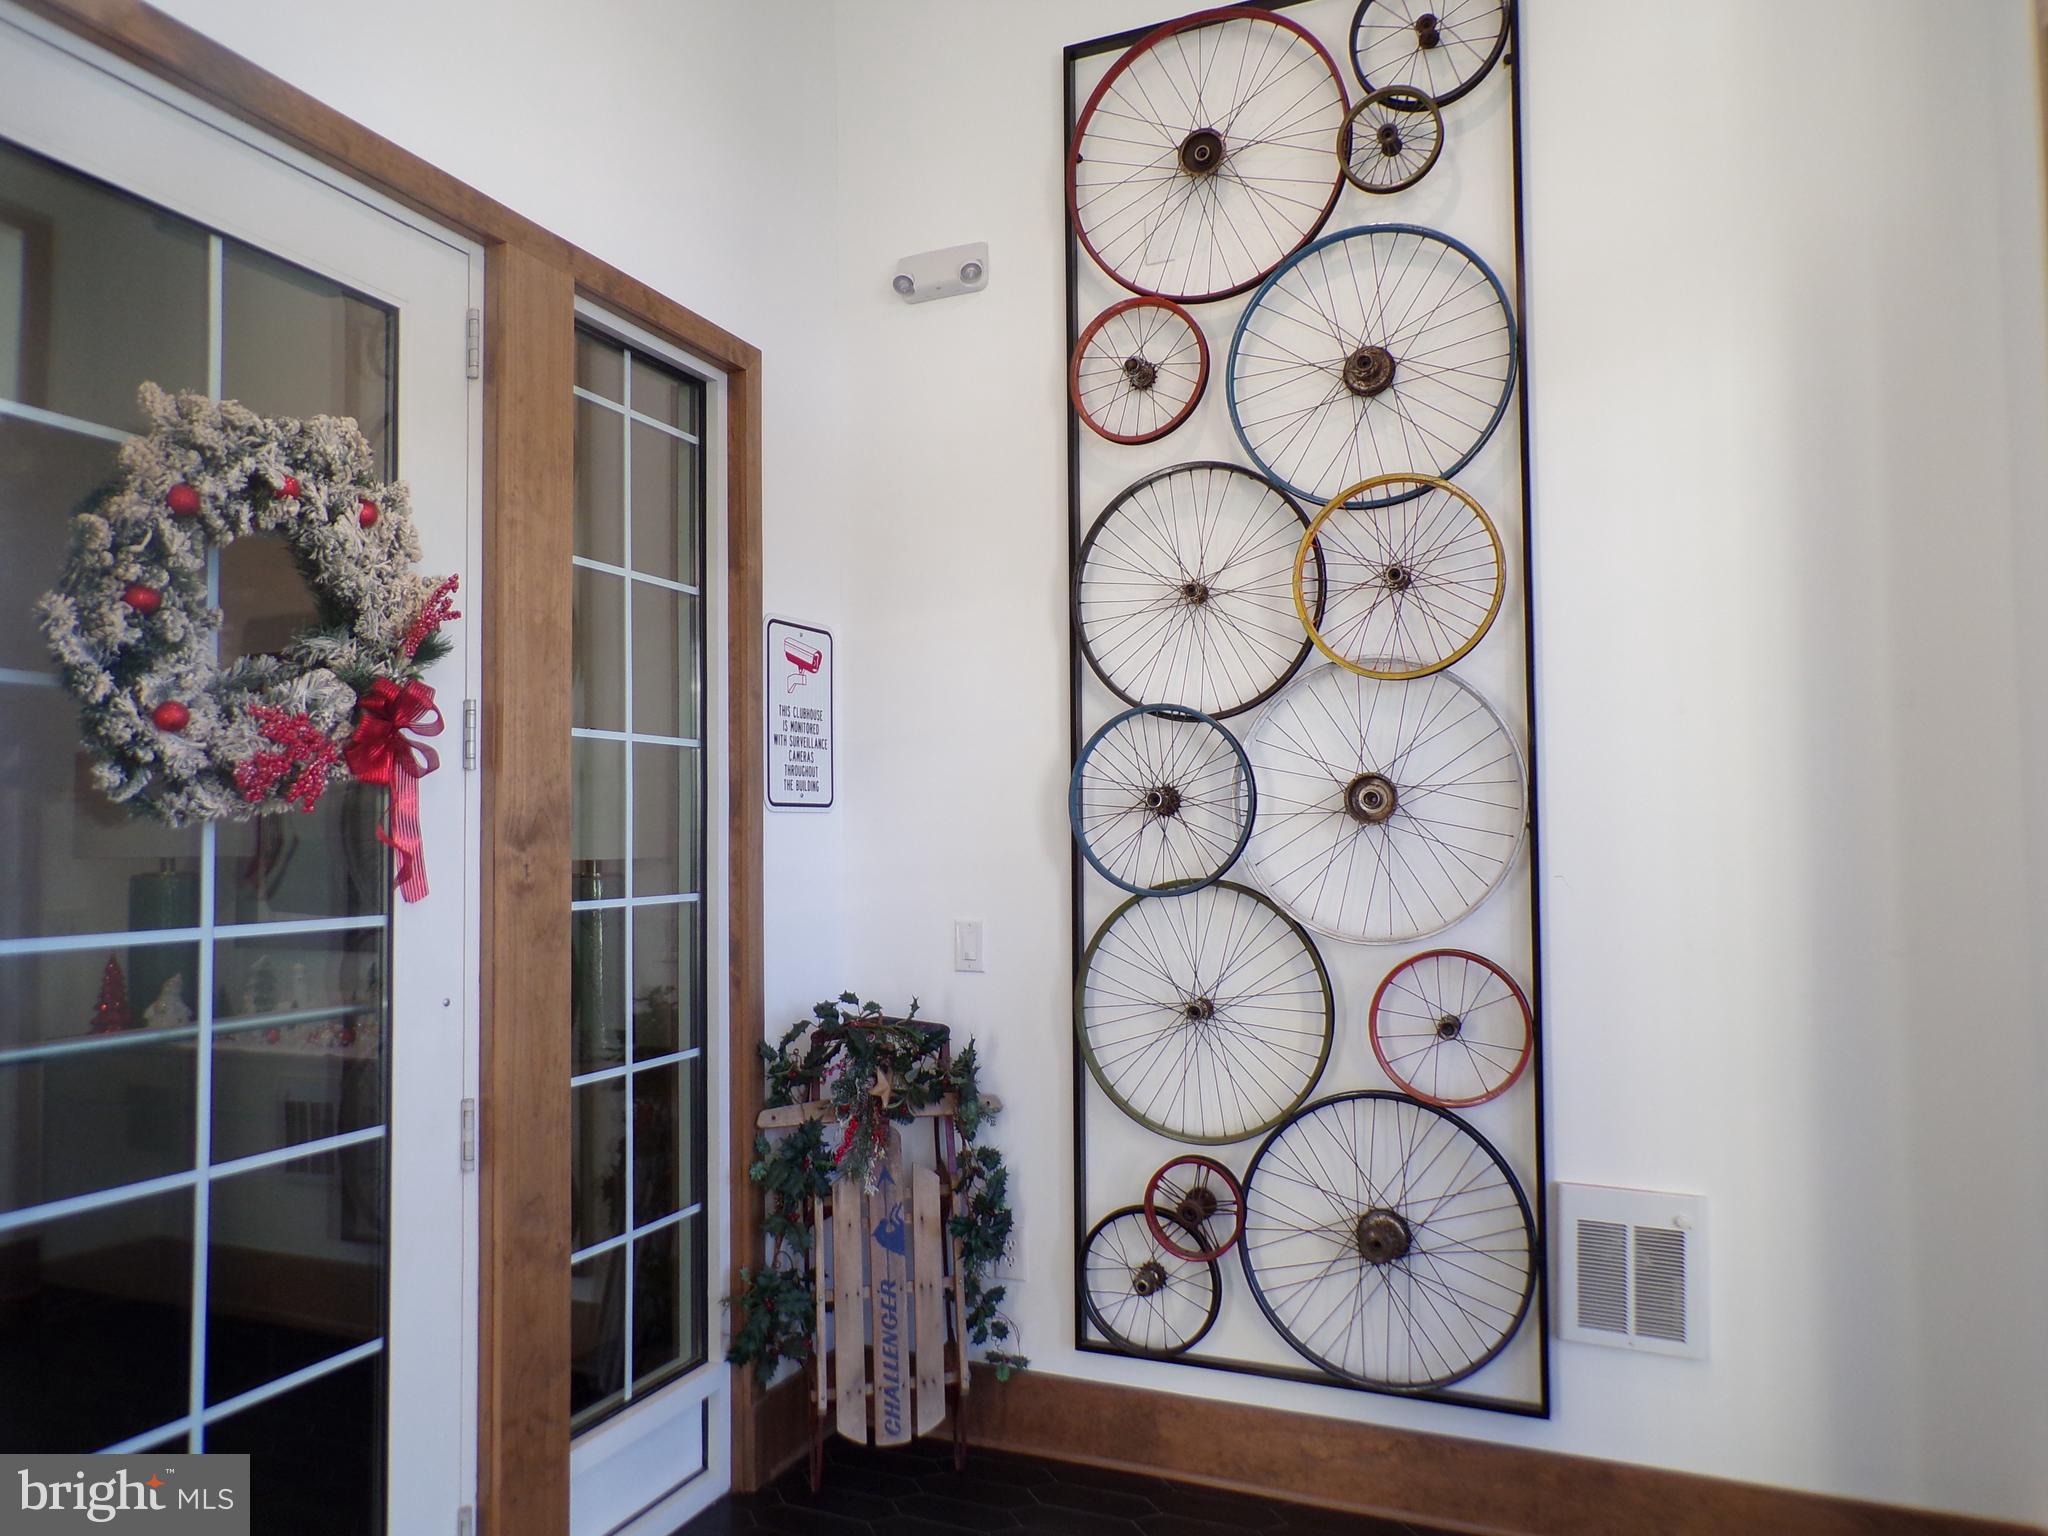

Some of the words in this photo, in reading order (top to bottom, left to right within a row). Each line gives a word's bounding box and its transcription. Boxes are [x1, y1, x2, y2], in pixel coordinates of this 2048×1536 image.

[779, 704, 791, 717] THIS
[793, 706, 823, 721] CLUBHOUSE
[782, 719, 788, 732] IS
[790, 720, 820, 735] MONITORED
[773, 733, 788, 747] WITH
[789, 735, 828, 751] SURVEILLANCE
[788, 749, 815, 763] CAMERAS
[784, 764, 819, 778] THROUGHOUT
[783, 778, 794, 791] THE
[795, 779, 820, 792] BUILDING
[880, 1278, 902, 1438] CHALLENGER
